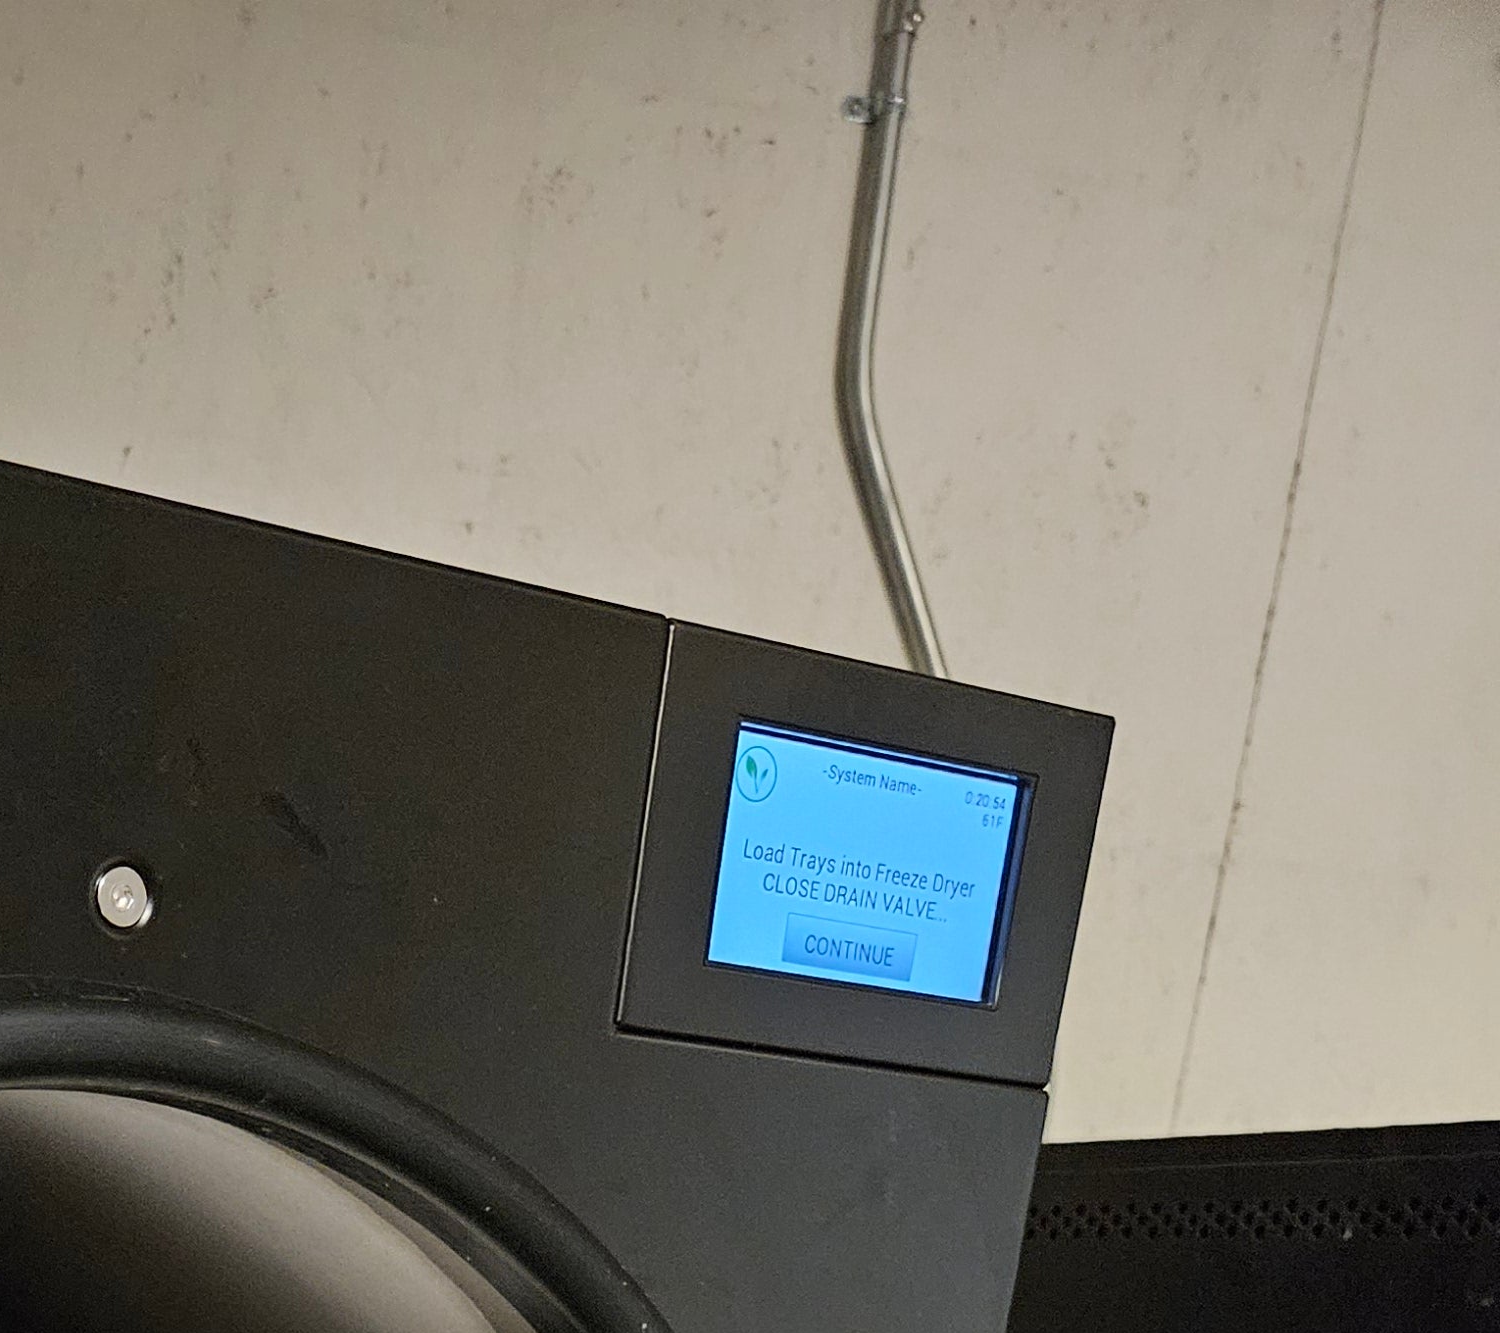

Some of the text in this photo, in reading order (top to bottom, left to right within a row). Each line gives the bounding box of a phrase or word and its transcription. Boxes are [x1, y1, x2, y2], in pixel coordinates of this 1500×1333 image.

[743, 838, 976, 900] Load Trays into Freeze Dryer
[763, 872, 821, 900] CLOSE
[823, 883, 878, 910] DRAIN
[804, 934, 895, 967] CONTINUE
